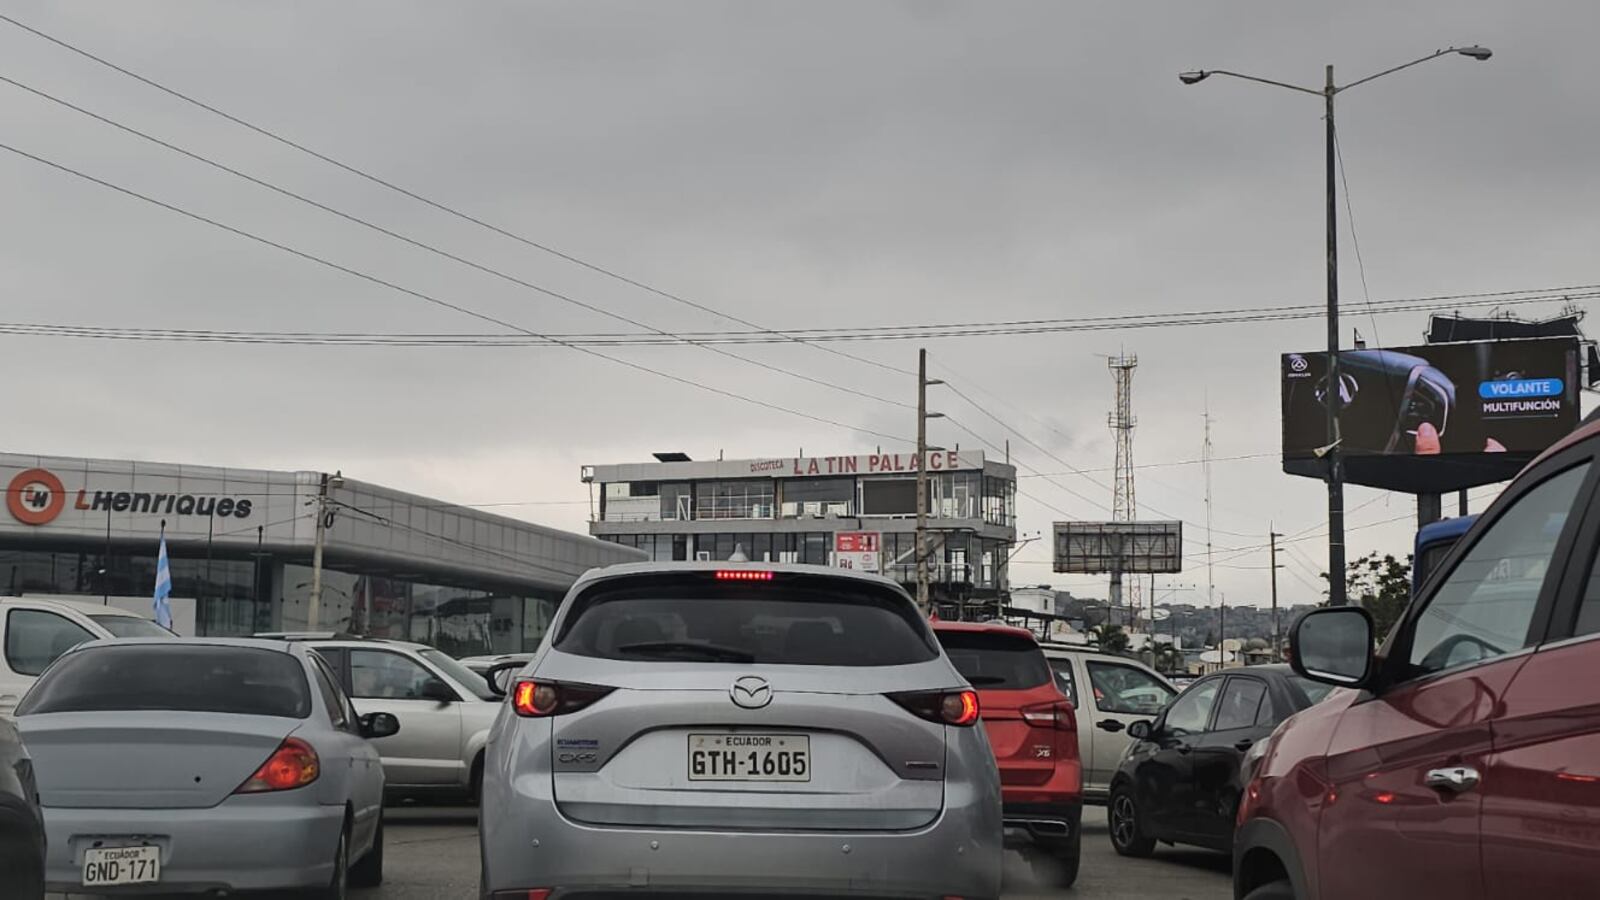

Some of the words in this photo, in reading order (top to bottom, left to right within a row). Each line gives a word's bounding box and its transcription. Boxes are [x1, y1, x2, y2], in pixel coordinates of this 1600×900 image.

[1491, 381, 1551, 394] VOLANTE
[1483, 399, 1560, 412] MULTIFUNCIÓN
[750, 458, 784, 472] DISCOTECA
[794, 455, 857, 474] LATIN
[869, 451, 958, 472] PALACE
[726, 737, 771, 746] ECUADOR
[692, 751, 806, 775] GTH-1605
[104, 850, 139, 860] ECUADOR
[86, 859, 155, 881] GND-171
